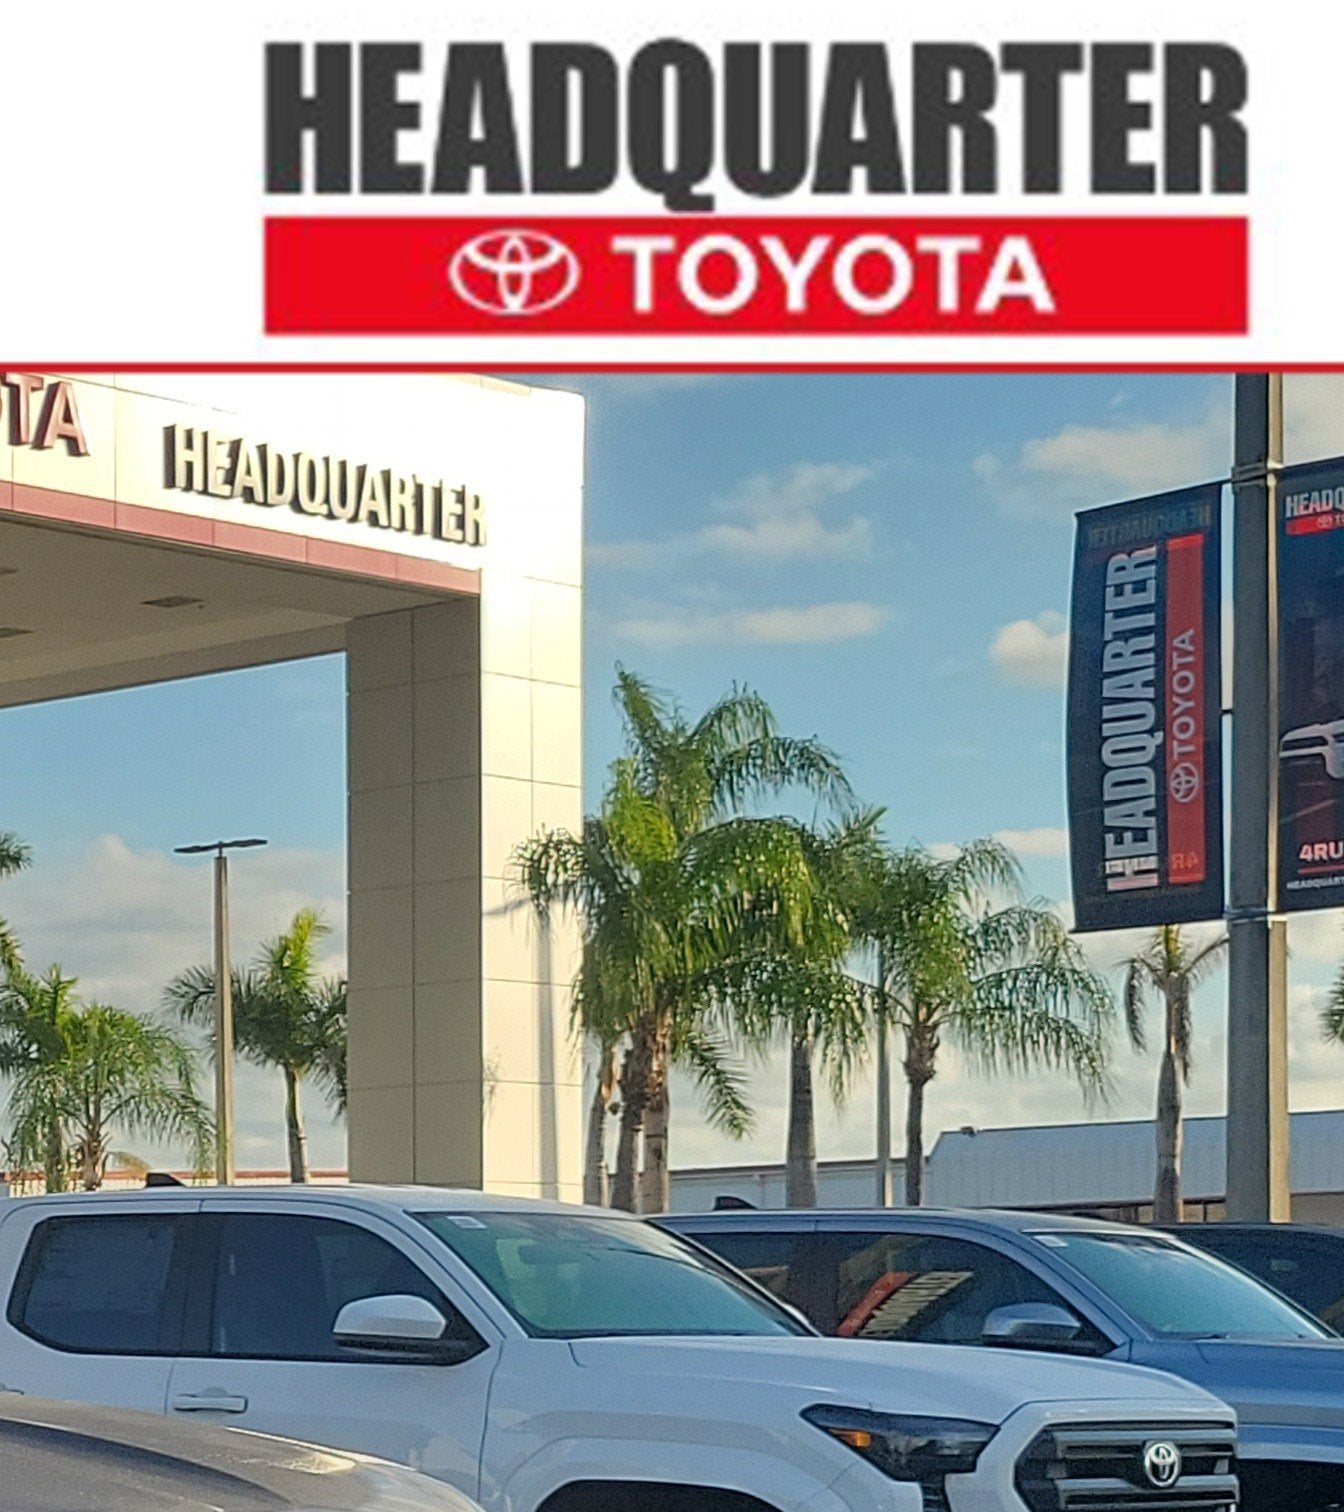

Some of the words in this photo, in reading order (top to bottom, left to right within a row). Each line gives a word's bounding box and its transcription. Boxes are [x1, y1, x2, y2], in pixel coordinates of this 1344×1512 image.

[162, 423, 489, 546] HEADQUARTER
[1101, 544, 1162, 890] HEADQUARTER
[1173, 628, 1196, 760] TOYOTA
